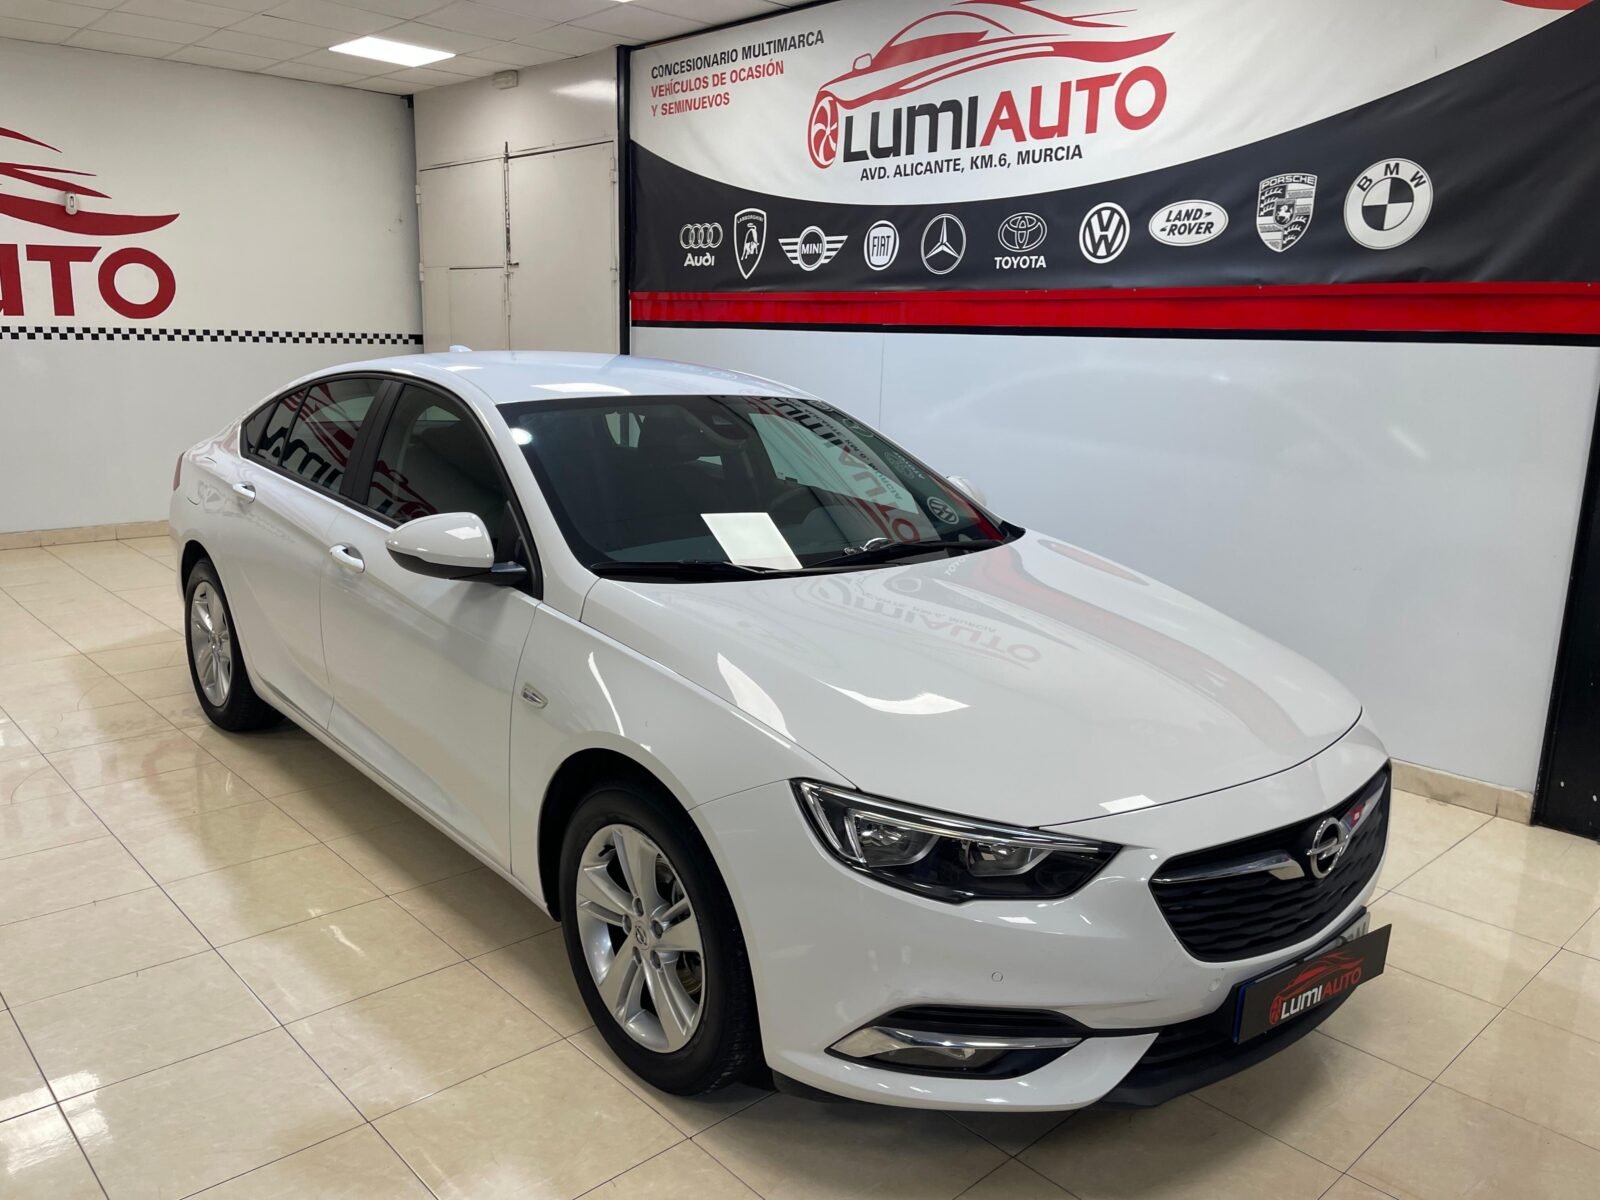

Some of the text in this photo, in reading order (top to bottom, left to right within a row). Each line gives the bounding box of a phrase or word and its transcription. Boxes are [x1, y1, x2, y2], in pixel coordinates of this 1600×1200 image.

[651, 29, 825, 79] CONCESIONARIO MULTIMARCA
[651, 58, 784, 98] VEHÍCULOS DE OCASIÓN
[651, 92, 730, 117] Y SEMINUEVOS
[860, 144, 1083, 181] AVD. ALICANTE, KM.6, MURCIA
[1261, 174, 1316, 190] PORSCHE
[1356, 162, 1427, 192] BMW
[801, 242, 822, 255] MINI
[871, 235, 892, 258] FIAT
[684, 252, 715, 267] Audi
[994, 255, 1047, 270] TOYOTA
